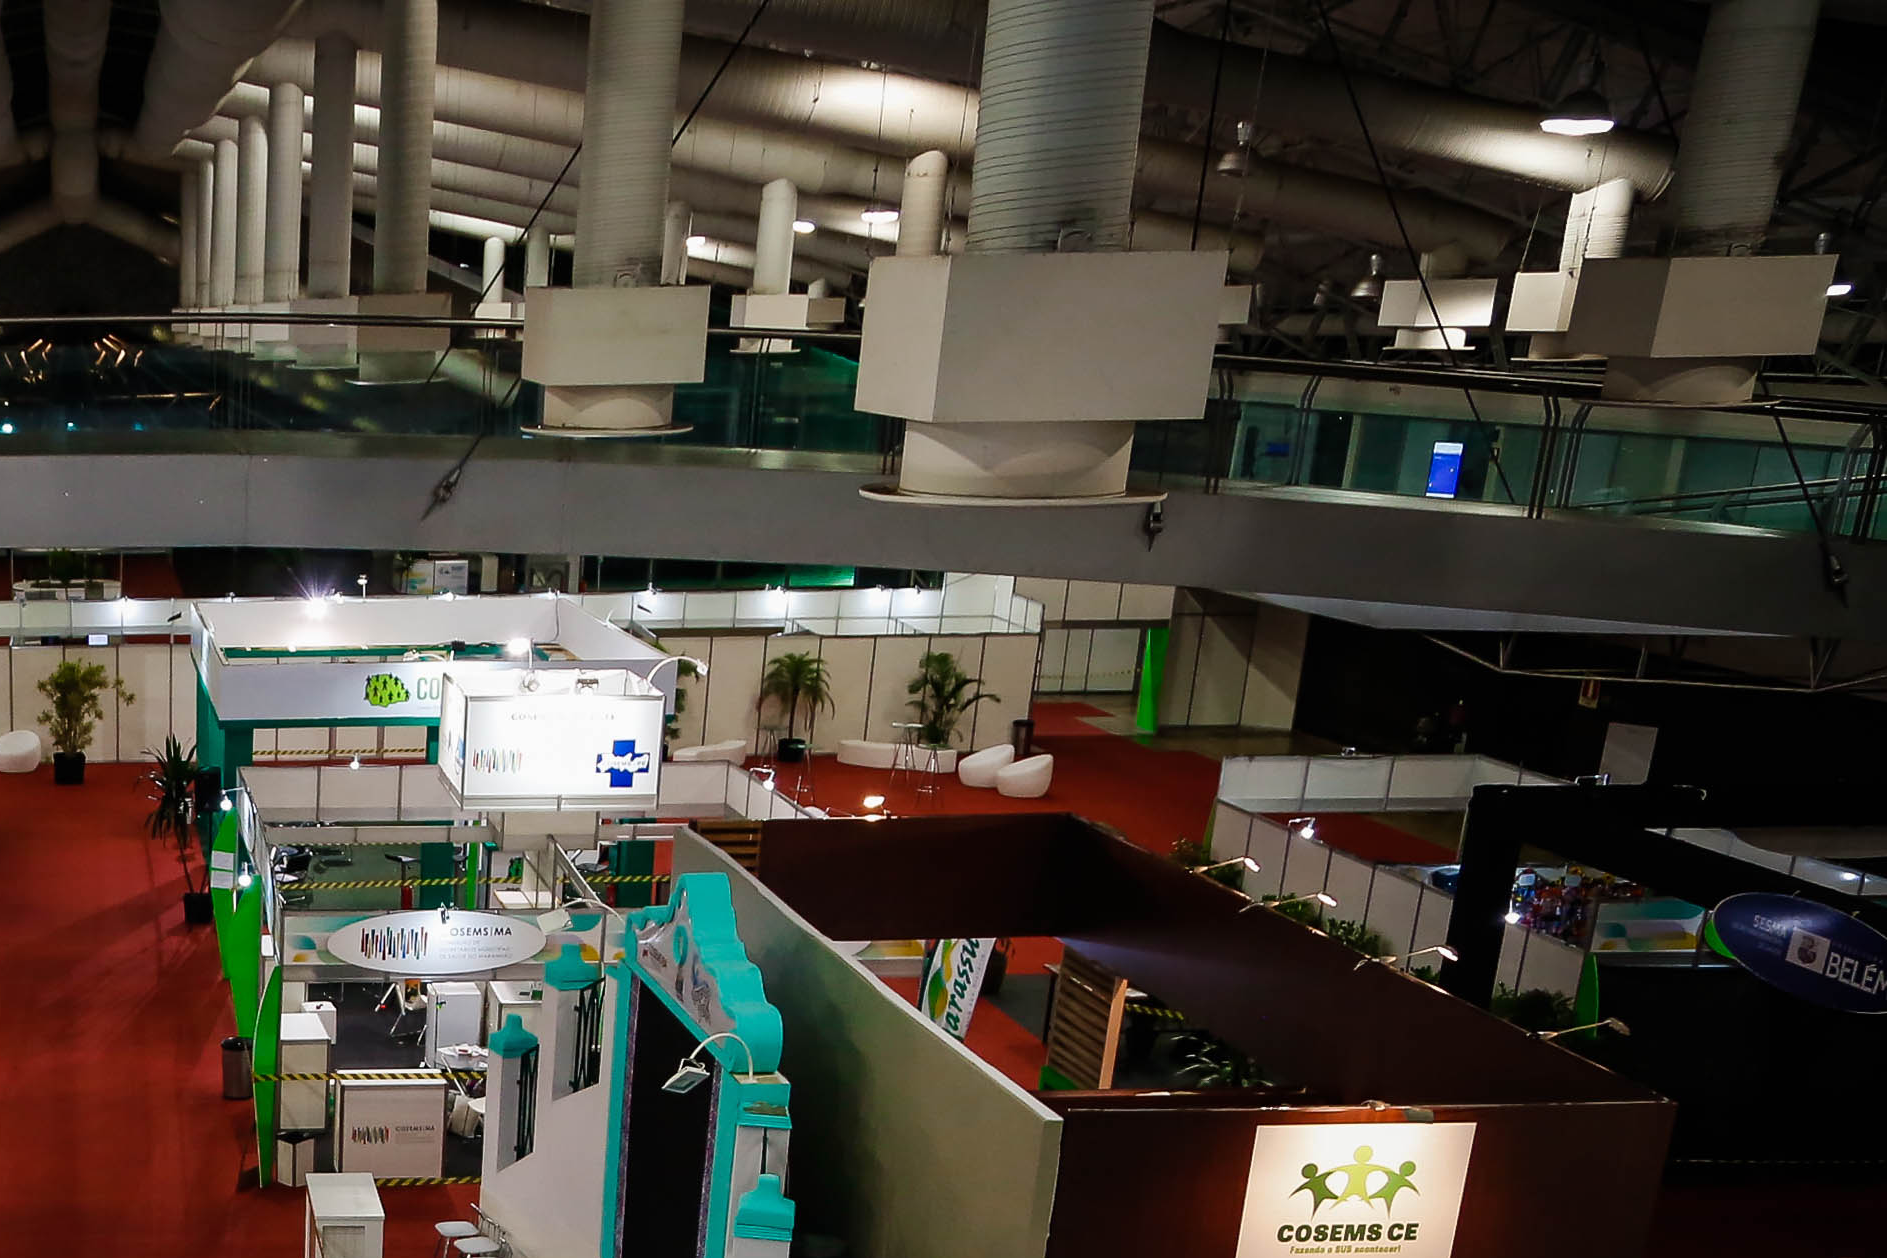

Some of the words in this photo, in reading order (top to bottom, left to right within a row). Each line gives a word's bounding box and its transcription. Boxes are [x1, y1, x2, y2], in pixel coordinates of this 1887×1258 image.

[1277, 1223, 1383, 1243] COSEMS
[1387, 1222, 1420, 1242] CE
[1289, 1245, 1325, 1255] Fazendo
[1334, 1245, 1352, 1254] SUS
[1354, 1244, 1401, 1254] acontecer!
